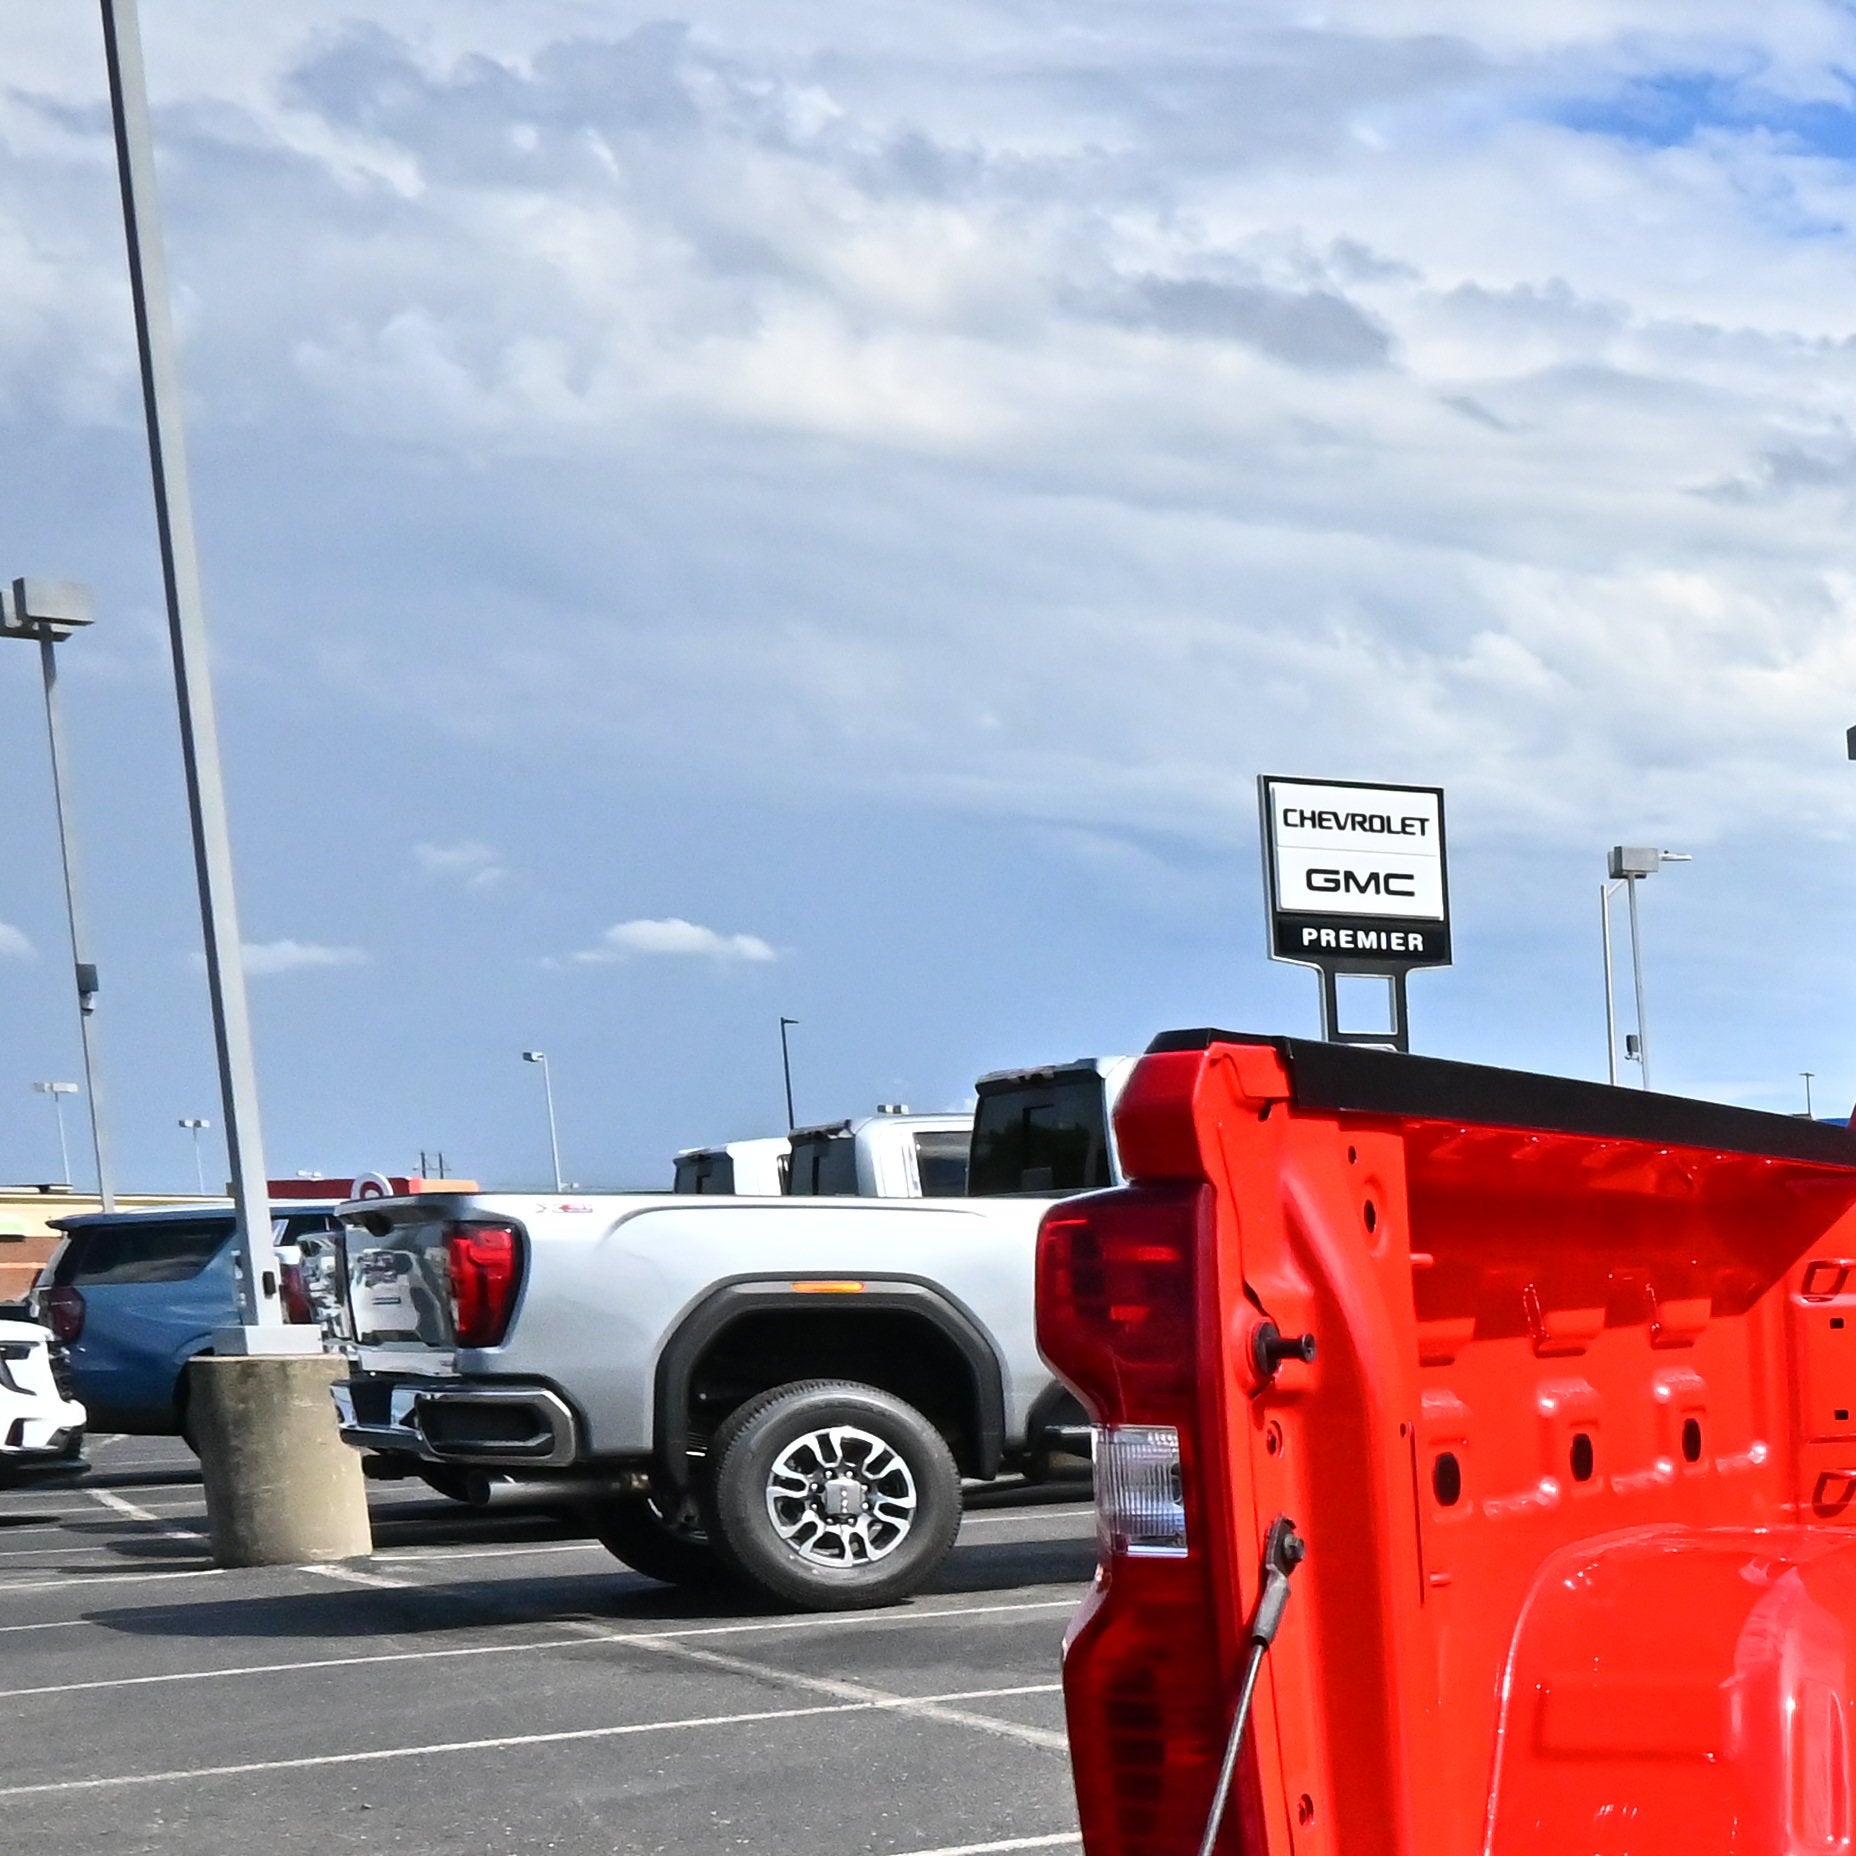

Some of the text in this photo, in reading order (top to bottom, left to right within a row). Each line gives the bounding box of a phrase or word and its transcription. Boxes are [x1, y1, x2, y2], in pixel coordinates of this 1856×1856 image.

[1283, 808, 1430, 837] CHEVROLET
[1306, 868, 1415, 897] GMC
[1301, 927, 1424, 952] PREMIER
